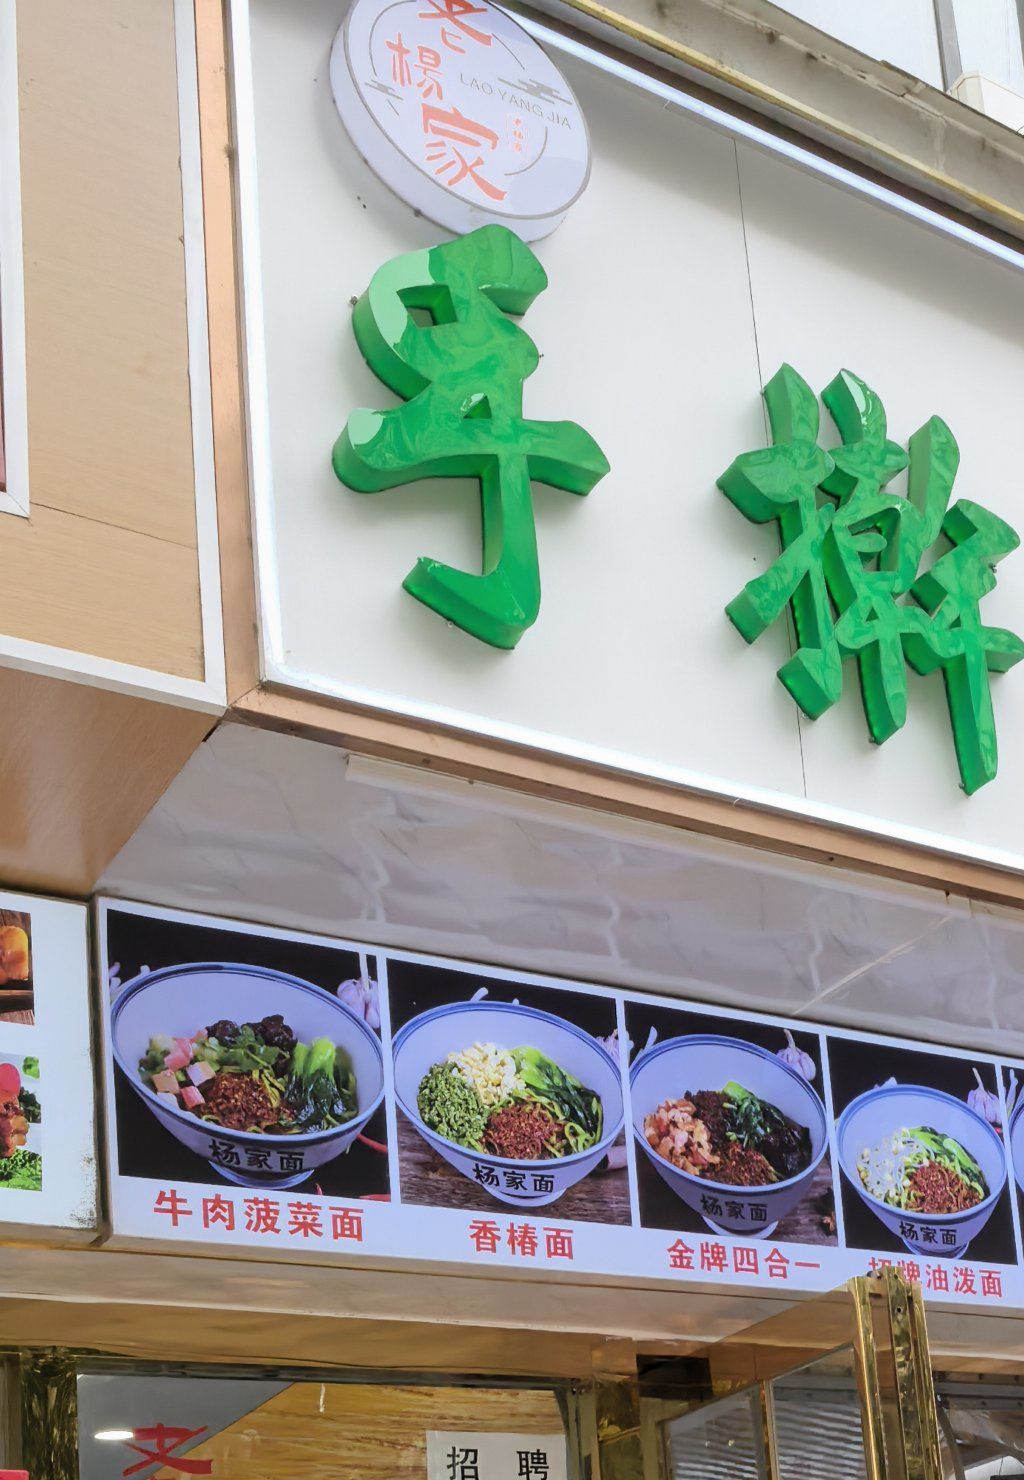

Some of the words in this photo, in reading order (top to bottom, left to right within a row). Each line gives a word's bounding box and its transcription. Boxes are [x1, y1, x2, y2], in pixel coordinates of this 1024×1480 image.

[459, 72, 493, 96] LAO
[497, 88, 544, 118] YANG
[547, 111, 572, 130] JIA
[208, 1138, 305, 1173] 杨家面
[472, 1163, 555, 1193] 杨家面
[153, 1189, 363, 1242] 牛肉菠菜面
[700, 1194, 768, 1222] 杨家面
[469, 1219, 574, 1260] 香椿面
[899, 1221, 957, 1246] 杨家面
[667, 1238, 820, 1279] 金牌四合一
